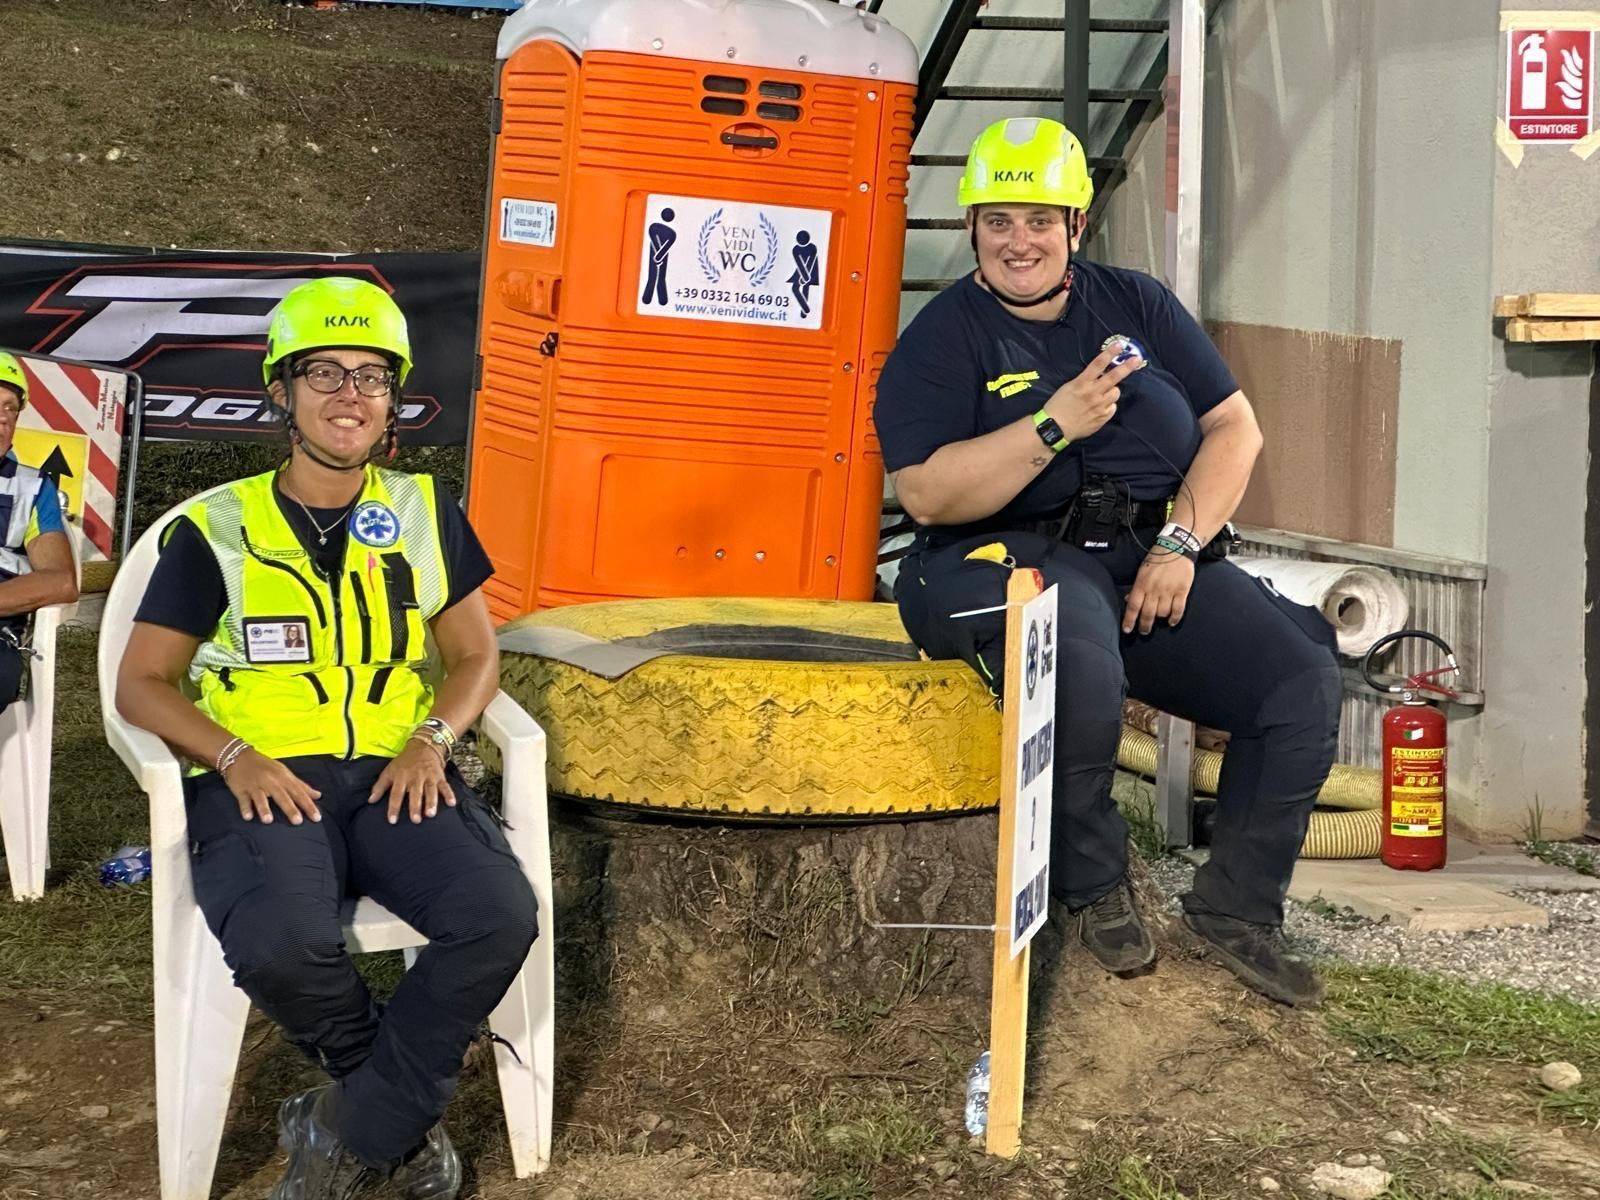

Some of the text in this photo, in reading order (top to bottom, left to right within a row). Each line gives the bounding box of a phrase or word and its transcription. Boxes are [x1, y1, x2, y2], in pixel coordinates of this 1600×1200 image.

[1520, 123, 1578, 134] ESTINTORE
[994, 170, 1034, 183] KASK
[722, 225, 755, 239] VENI
[723, 238, 752, 252] VIDI
[718, 250, 757, 273] WC
[675, 287, 790, 308] +39 0332 164 69 03
[674, 303, 788, 321] www.venividiwc.it
[325, 315, 371, 329] KASK
